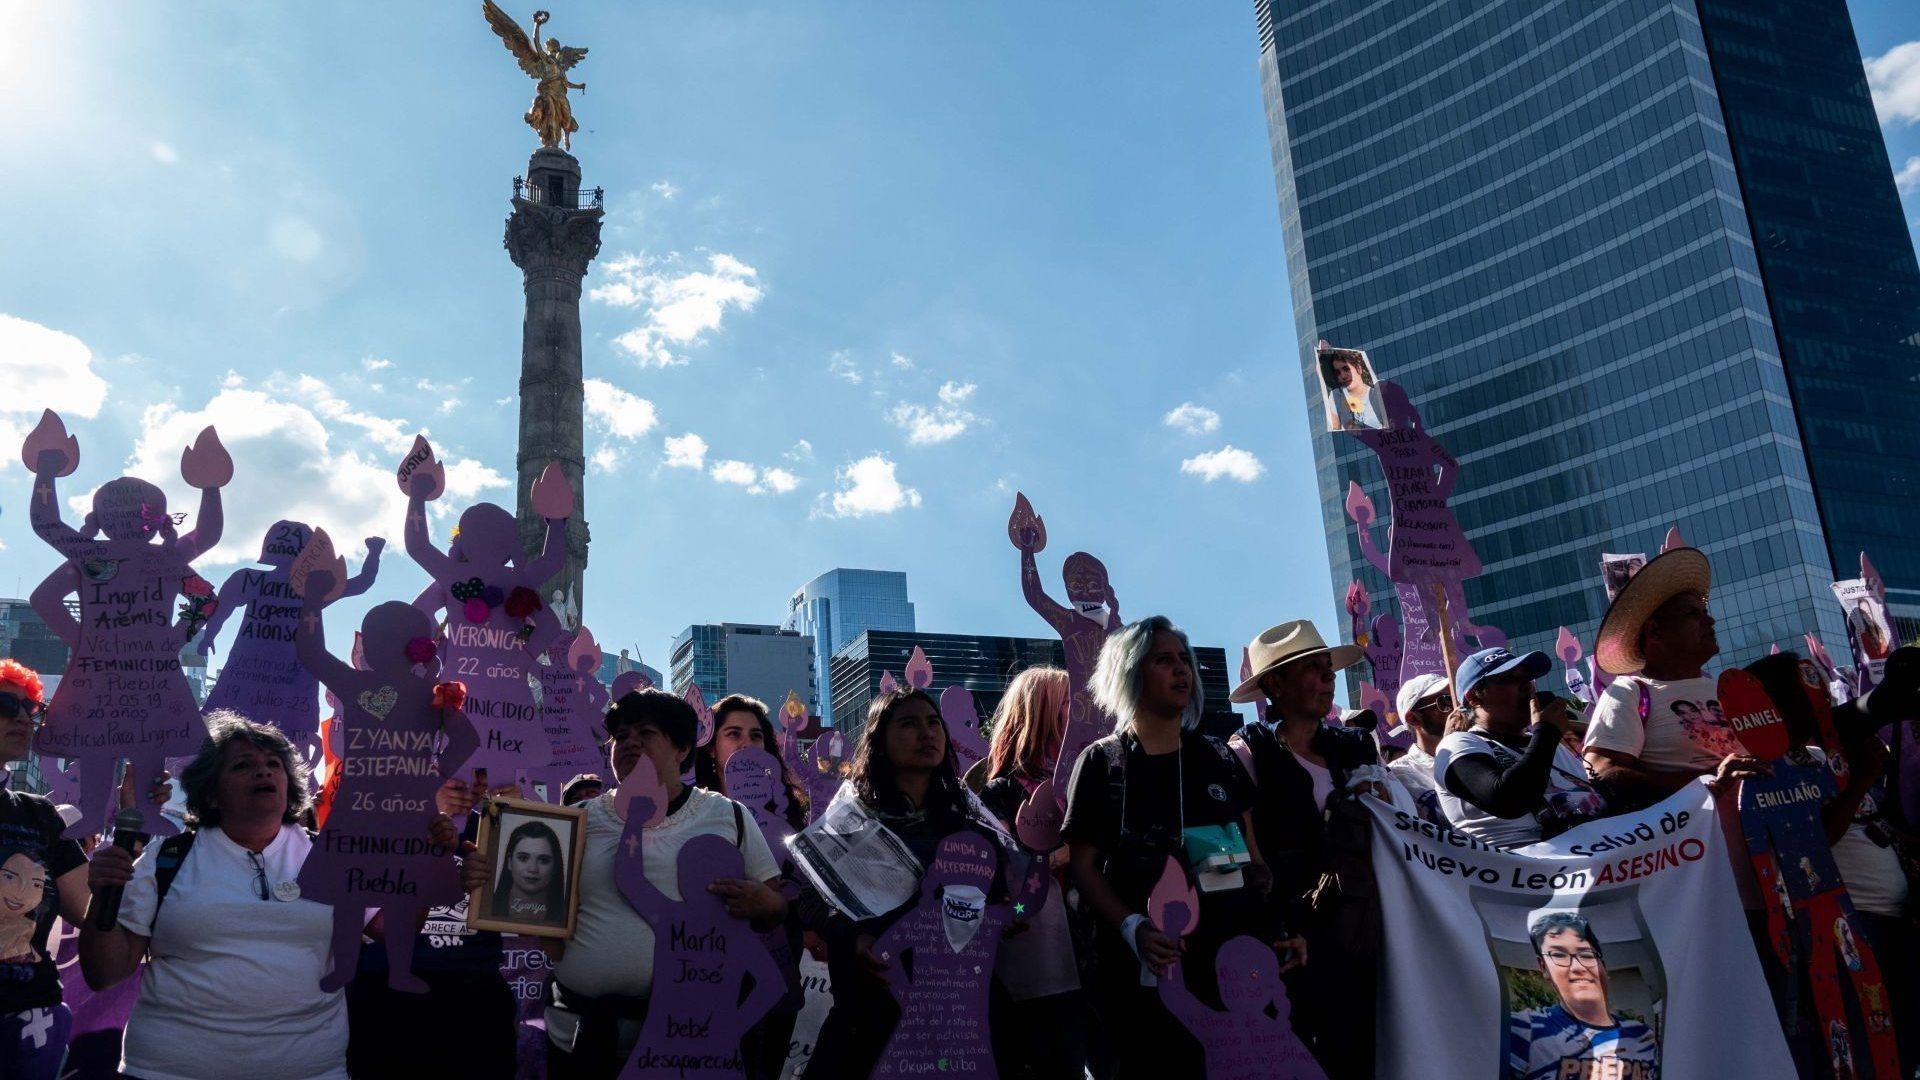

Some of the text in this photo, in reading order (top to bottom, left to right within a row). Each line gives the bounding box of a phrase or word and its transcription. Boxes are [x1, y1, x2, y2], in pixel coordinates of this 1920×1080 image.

[1390, 447, 1418, 458] PARA
[88, 577, 163, 615] Ingrid
[448, 621, 524, 651] VERÓNICA
[78, 657, 181, 673] FEMINICIDIO
[457, 657, 520, 680] 22 años
[108, 673, 171, 692] Puebla
[87, 708, 149, 720] 20 años
[1731, 709, 1783, 732] DANIEL
[347, 727, 435, 751] ZYANYA
[488, 729, 524, 753] Mex
[344, 756, 440, 778] ESTEFANIA
[352, 791, 429, 812] 26 años
[1570, 823, 1656, 858] Salud
[1660, 809, 1691, 834] de
[943, 841, 976, 856] LINDA
[1403, 838, 1705, 891] Nuevo León ASESINO
[345, 867, 417, 896] Puebla
[670, 920, 726, 955] María
[672, 957, 724, 984] José
[665, 1012, 713, 1039] bebé
